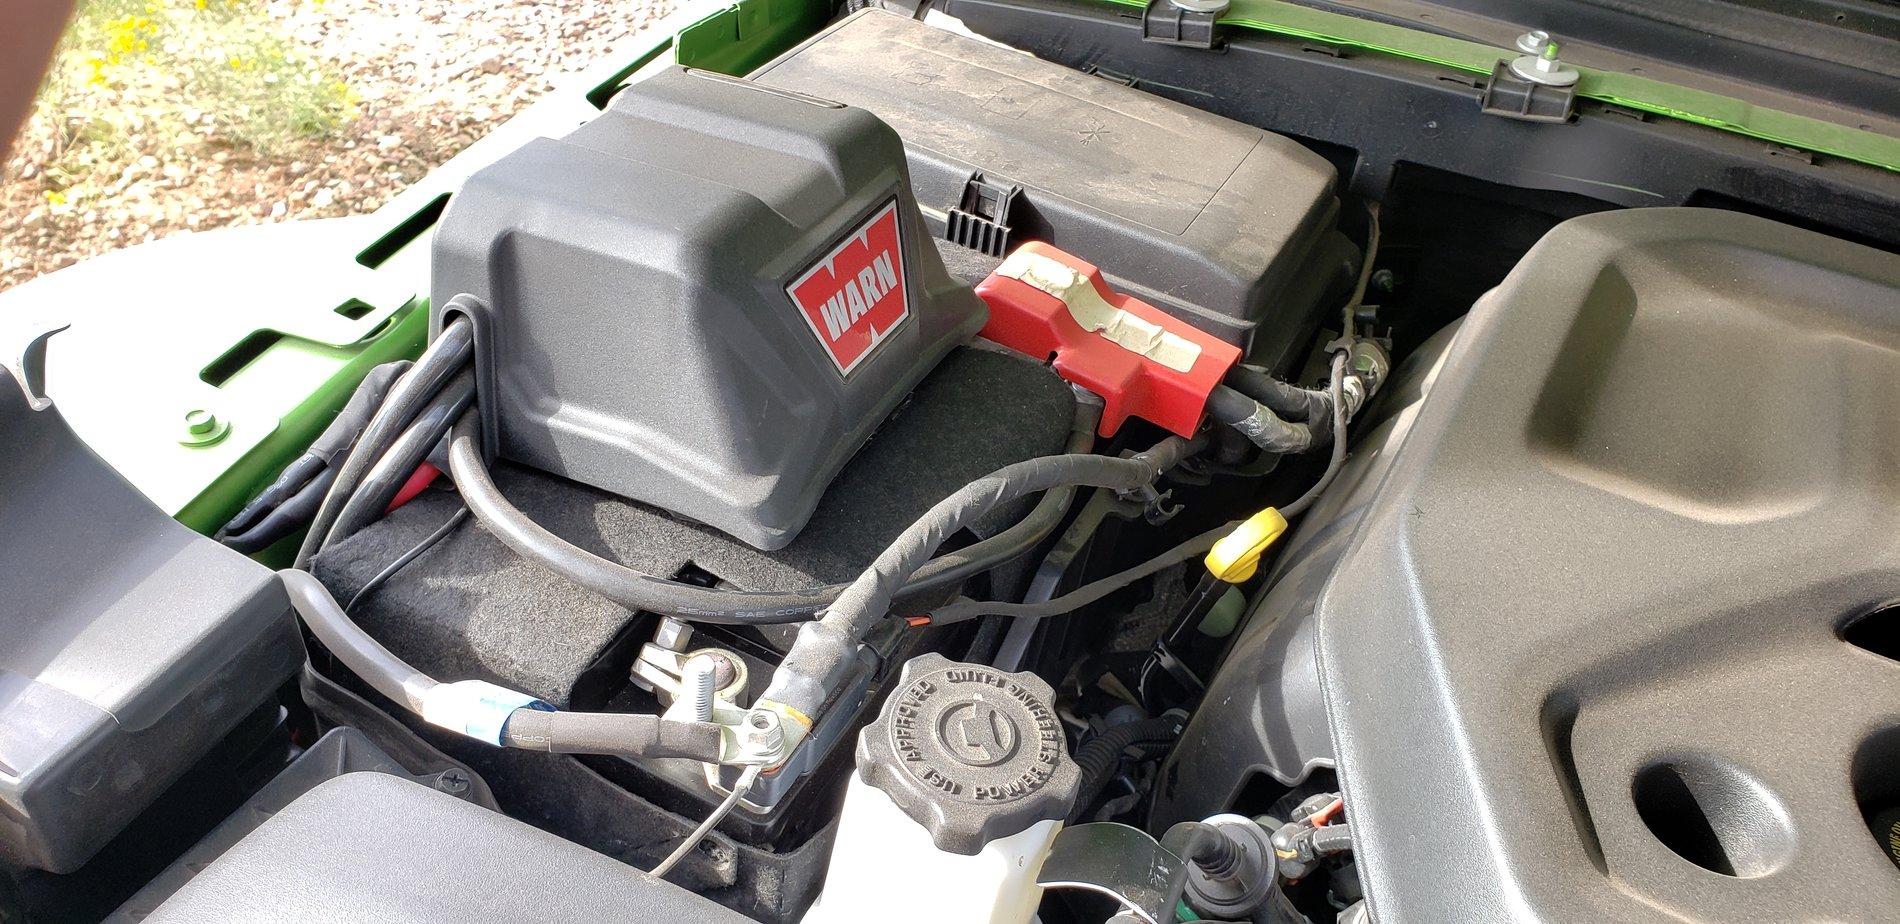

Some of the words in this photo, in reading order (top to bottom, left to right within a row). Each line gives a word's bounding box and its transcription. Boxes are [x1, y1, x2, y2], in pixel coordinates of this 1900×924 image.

[819, 249, 898, 342] WARN
[734, 610, 766, 619] SAE
[896, 680, 937, 763] APPROVED
[1008, 684, 1061, 764] STEERING
[918, 764, 963, 795] USE
[975, 766, 1047, 799] POWER
